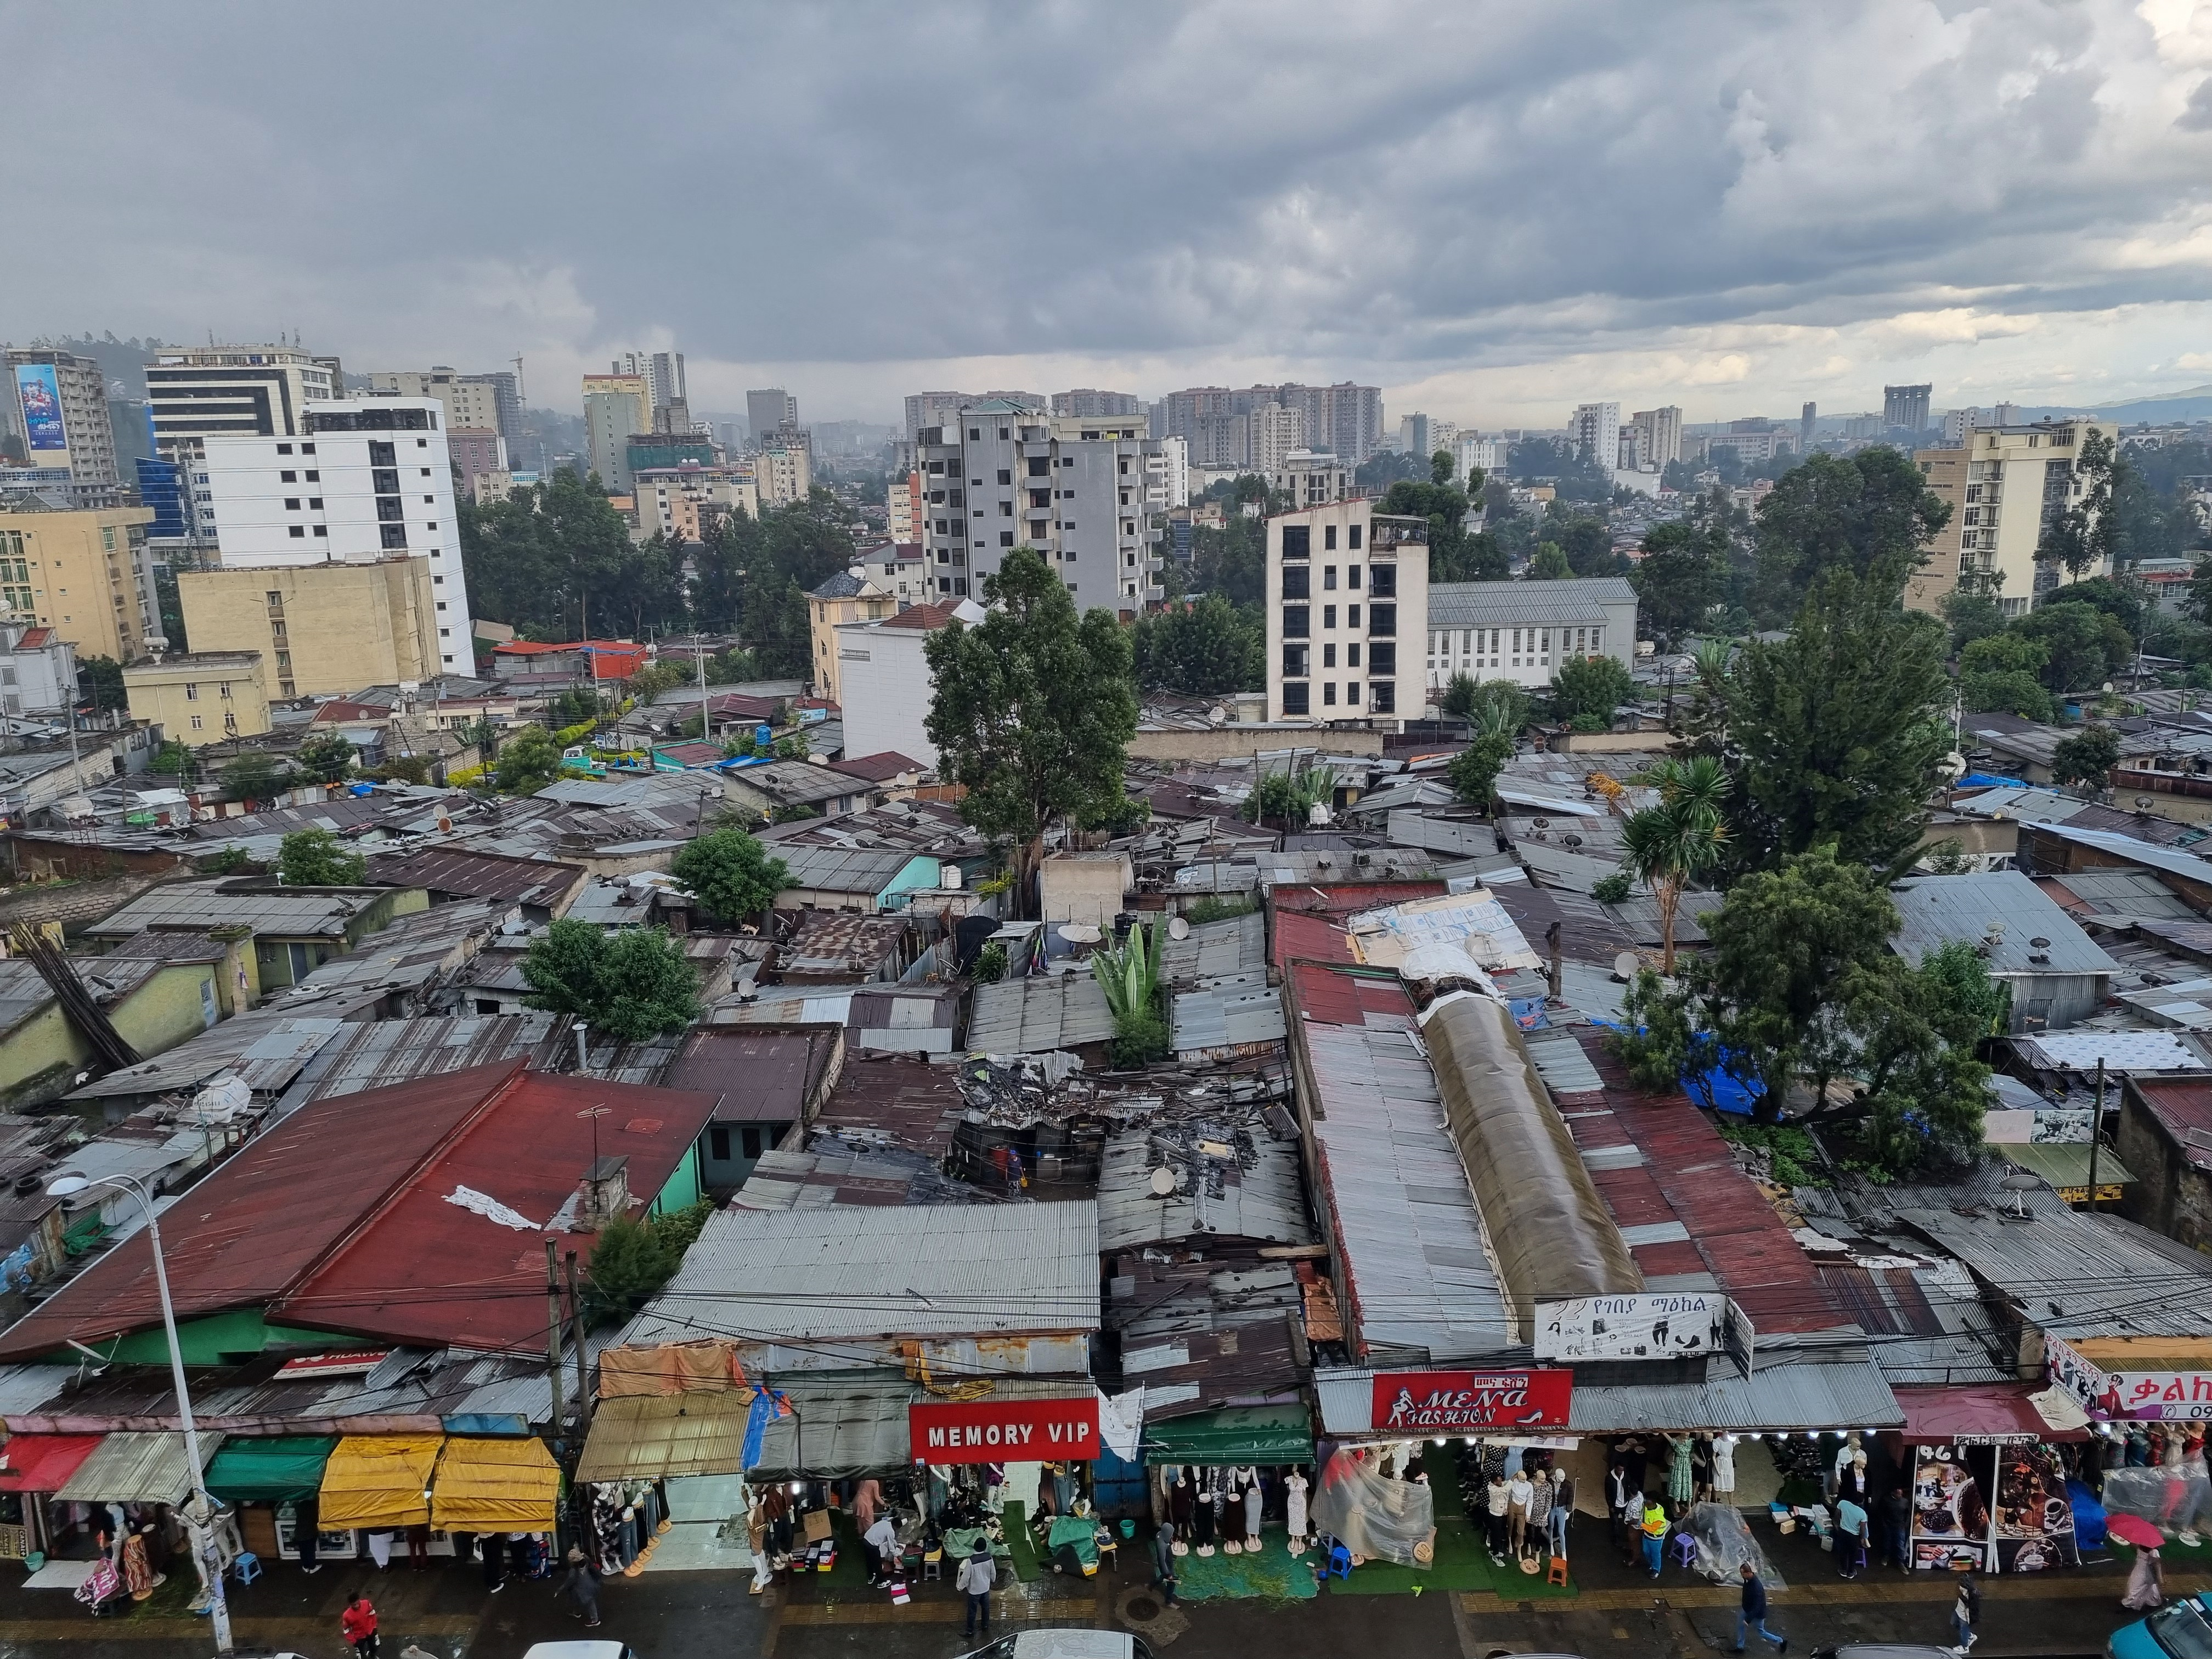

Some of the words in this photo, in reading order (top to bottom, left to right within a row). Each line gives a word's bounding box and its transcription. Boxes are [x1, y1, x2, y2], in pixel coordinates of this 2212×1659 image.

[1594, 1298, 1637, 1314] የገበያ
[1651, 1296, 1707, 1312] ማዕከል
[329, 1350, 390, 1359] HUAWE
[929, 1424, 1034, 1447] MEMORY
[1048, 1422, 1089, 1443] VIP
